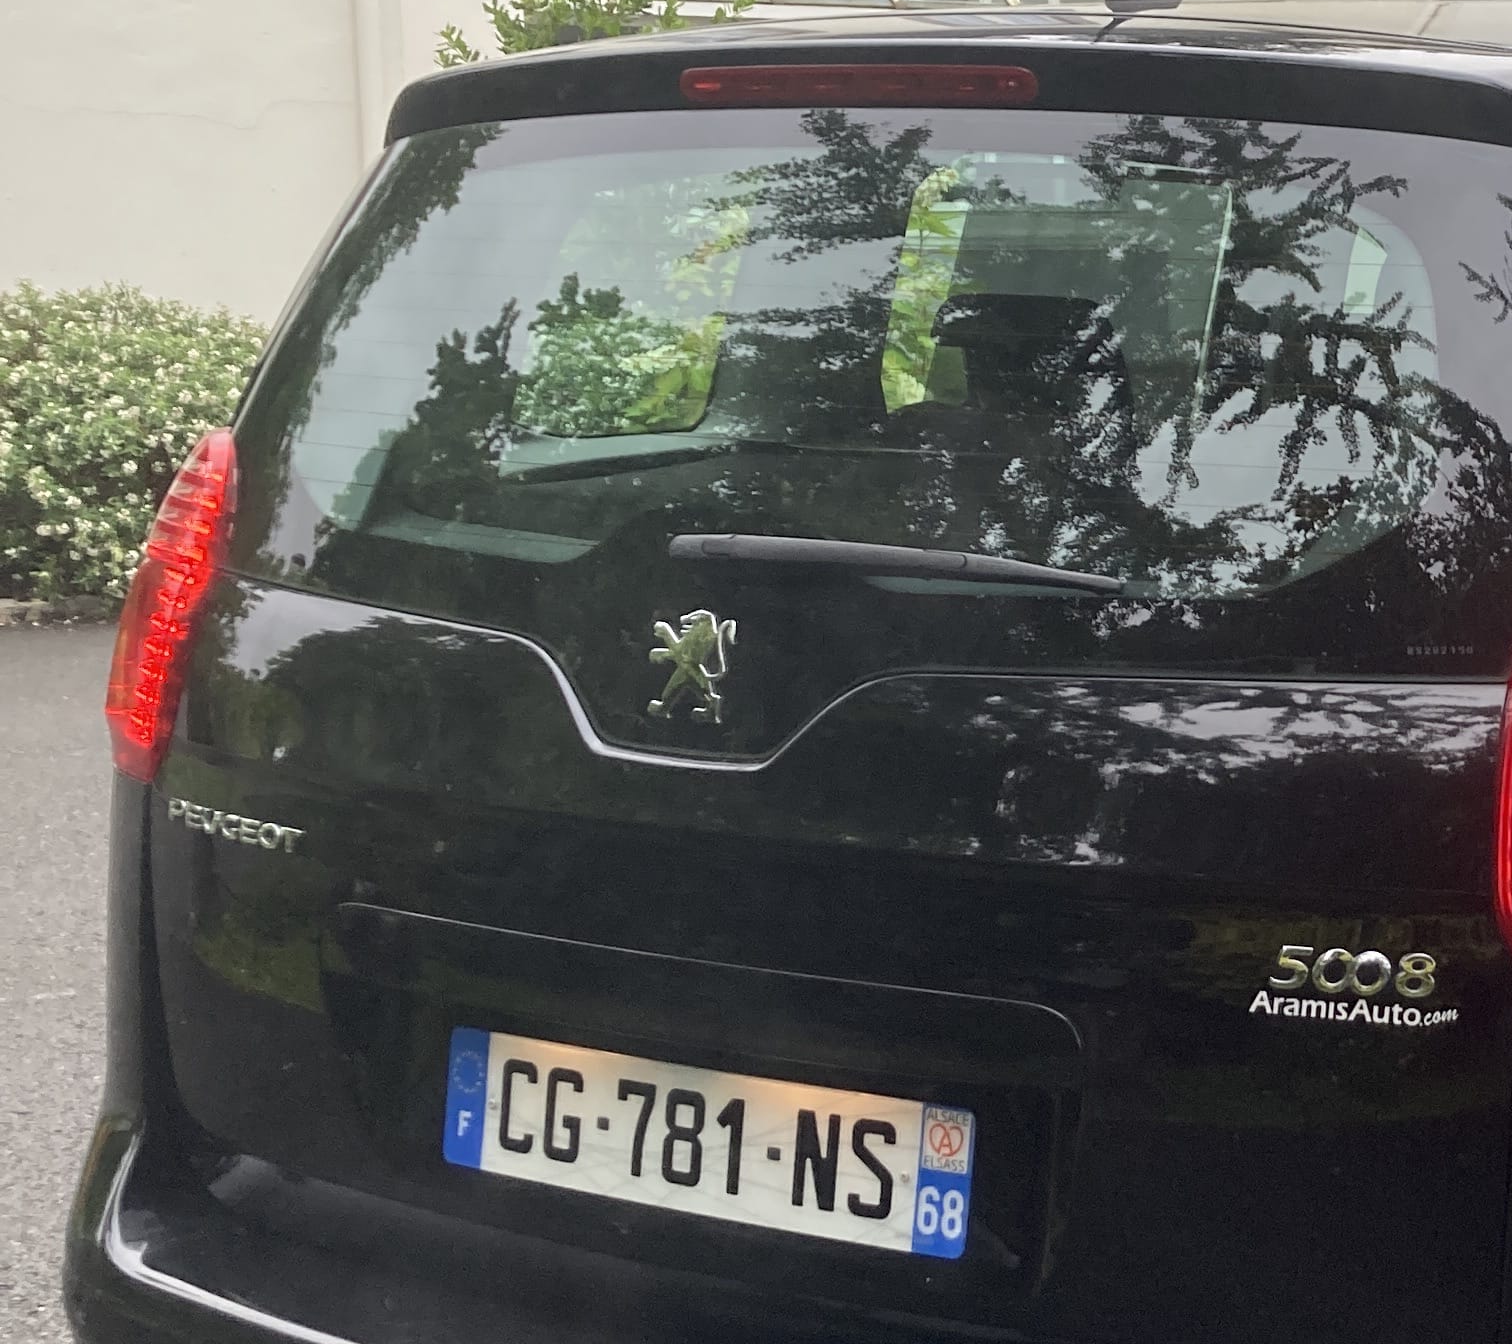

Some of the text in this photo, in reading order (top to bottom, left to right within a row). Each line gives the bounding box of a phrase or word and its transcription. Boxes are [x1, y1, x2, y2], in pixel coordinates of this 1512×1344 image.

[167, 797, 307, 854] PEUGEOT
[1268, 945, 1437, 998] 5008
[1248, 990, 1458, 1027] AramisAuto.com
[457, 1109, 472, 1137] F
[498, 1058, 898, 1220] CG-781-NS
[926, 1108, 970, 1127] ALSACE
[924, 1155, 966, 1172] ELSASS
[916, 1185, 965, 1239] 68
